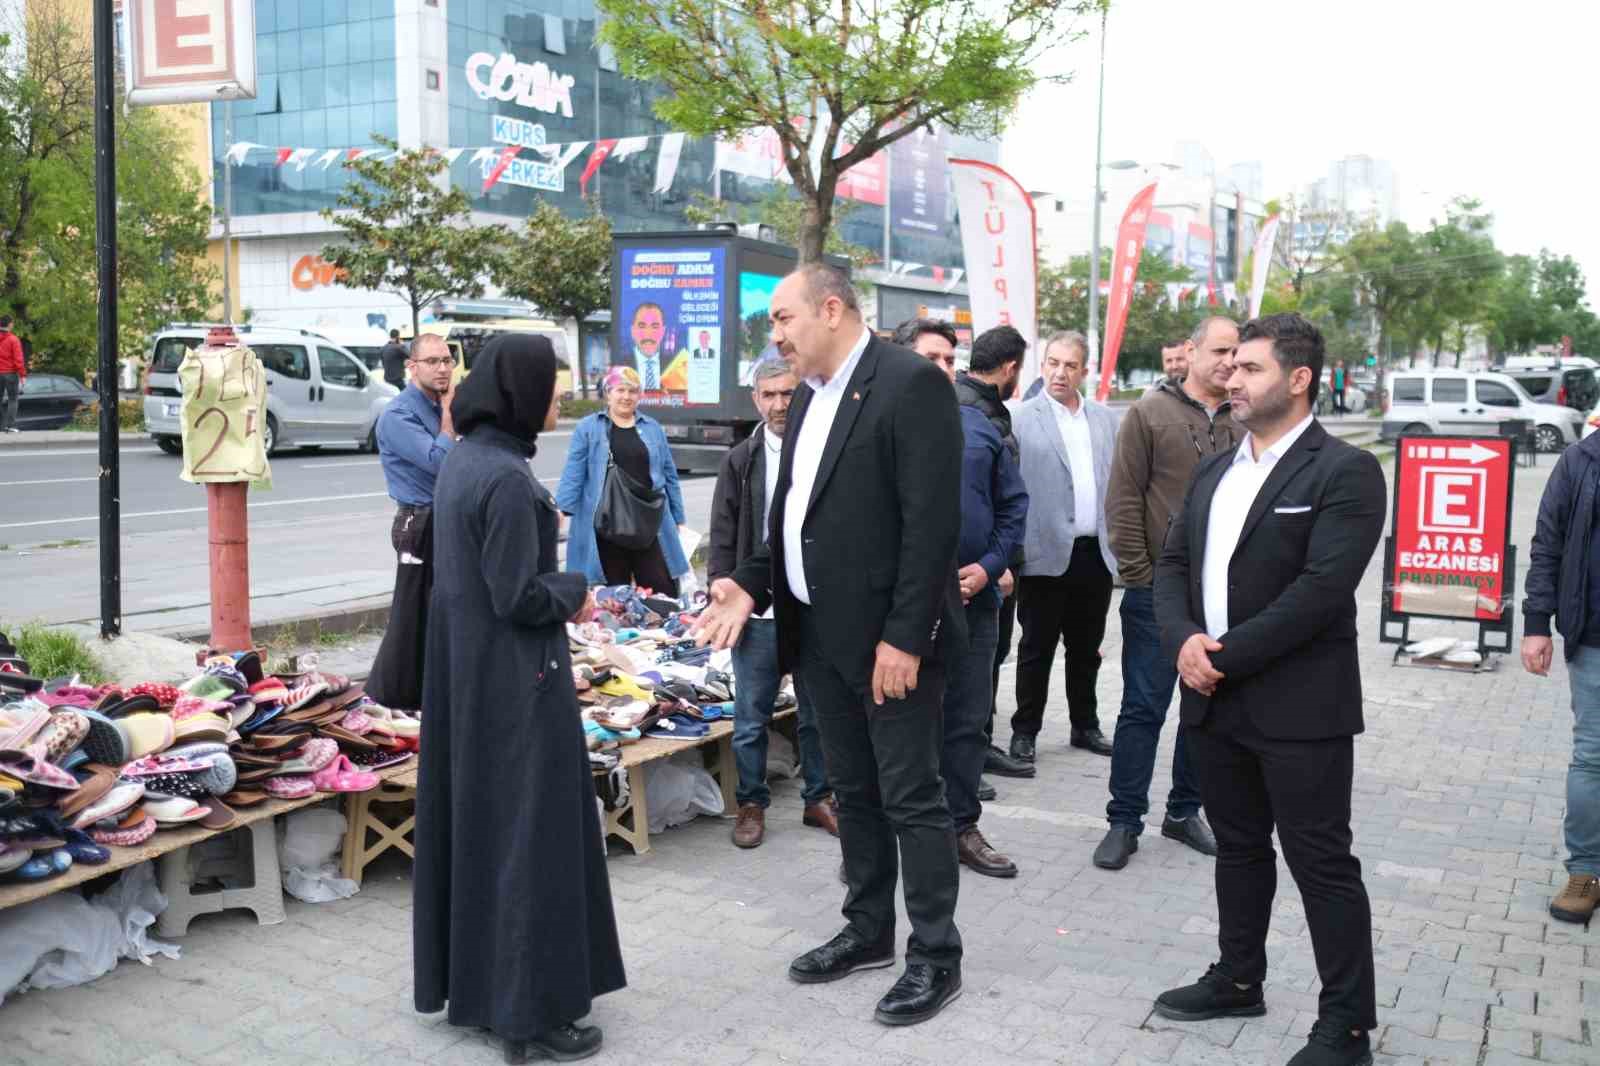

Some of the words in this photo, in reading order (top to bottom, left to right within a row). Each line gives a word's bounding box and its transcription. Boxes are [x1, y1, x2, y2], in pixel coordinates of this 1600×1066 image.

[154, 0, 214, 68] E
[495, 118, 546, 146] KURS
[1432, 474, 1473, 526] E
[1417, 535, 1483, 554] ARAS
[1400, 552, 1500, 574] ECZANESİ
[1399, 572, 1496, 589] PHARMACY
